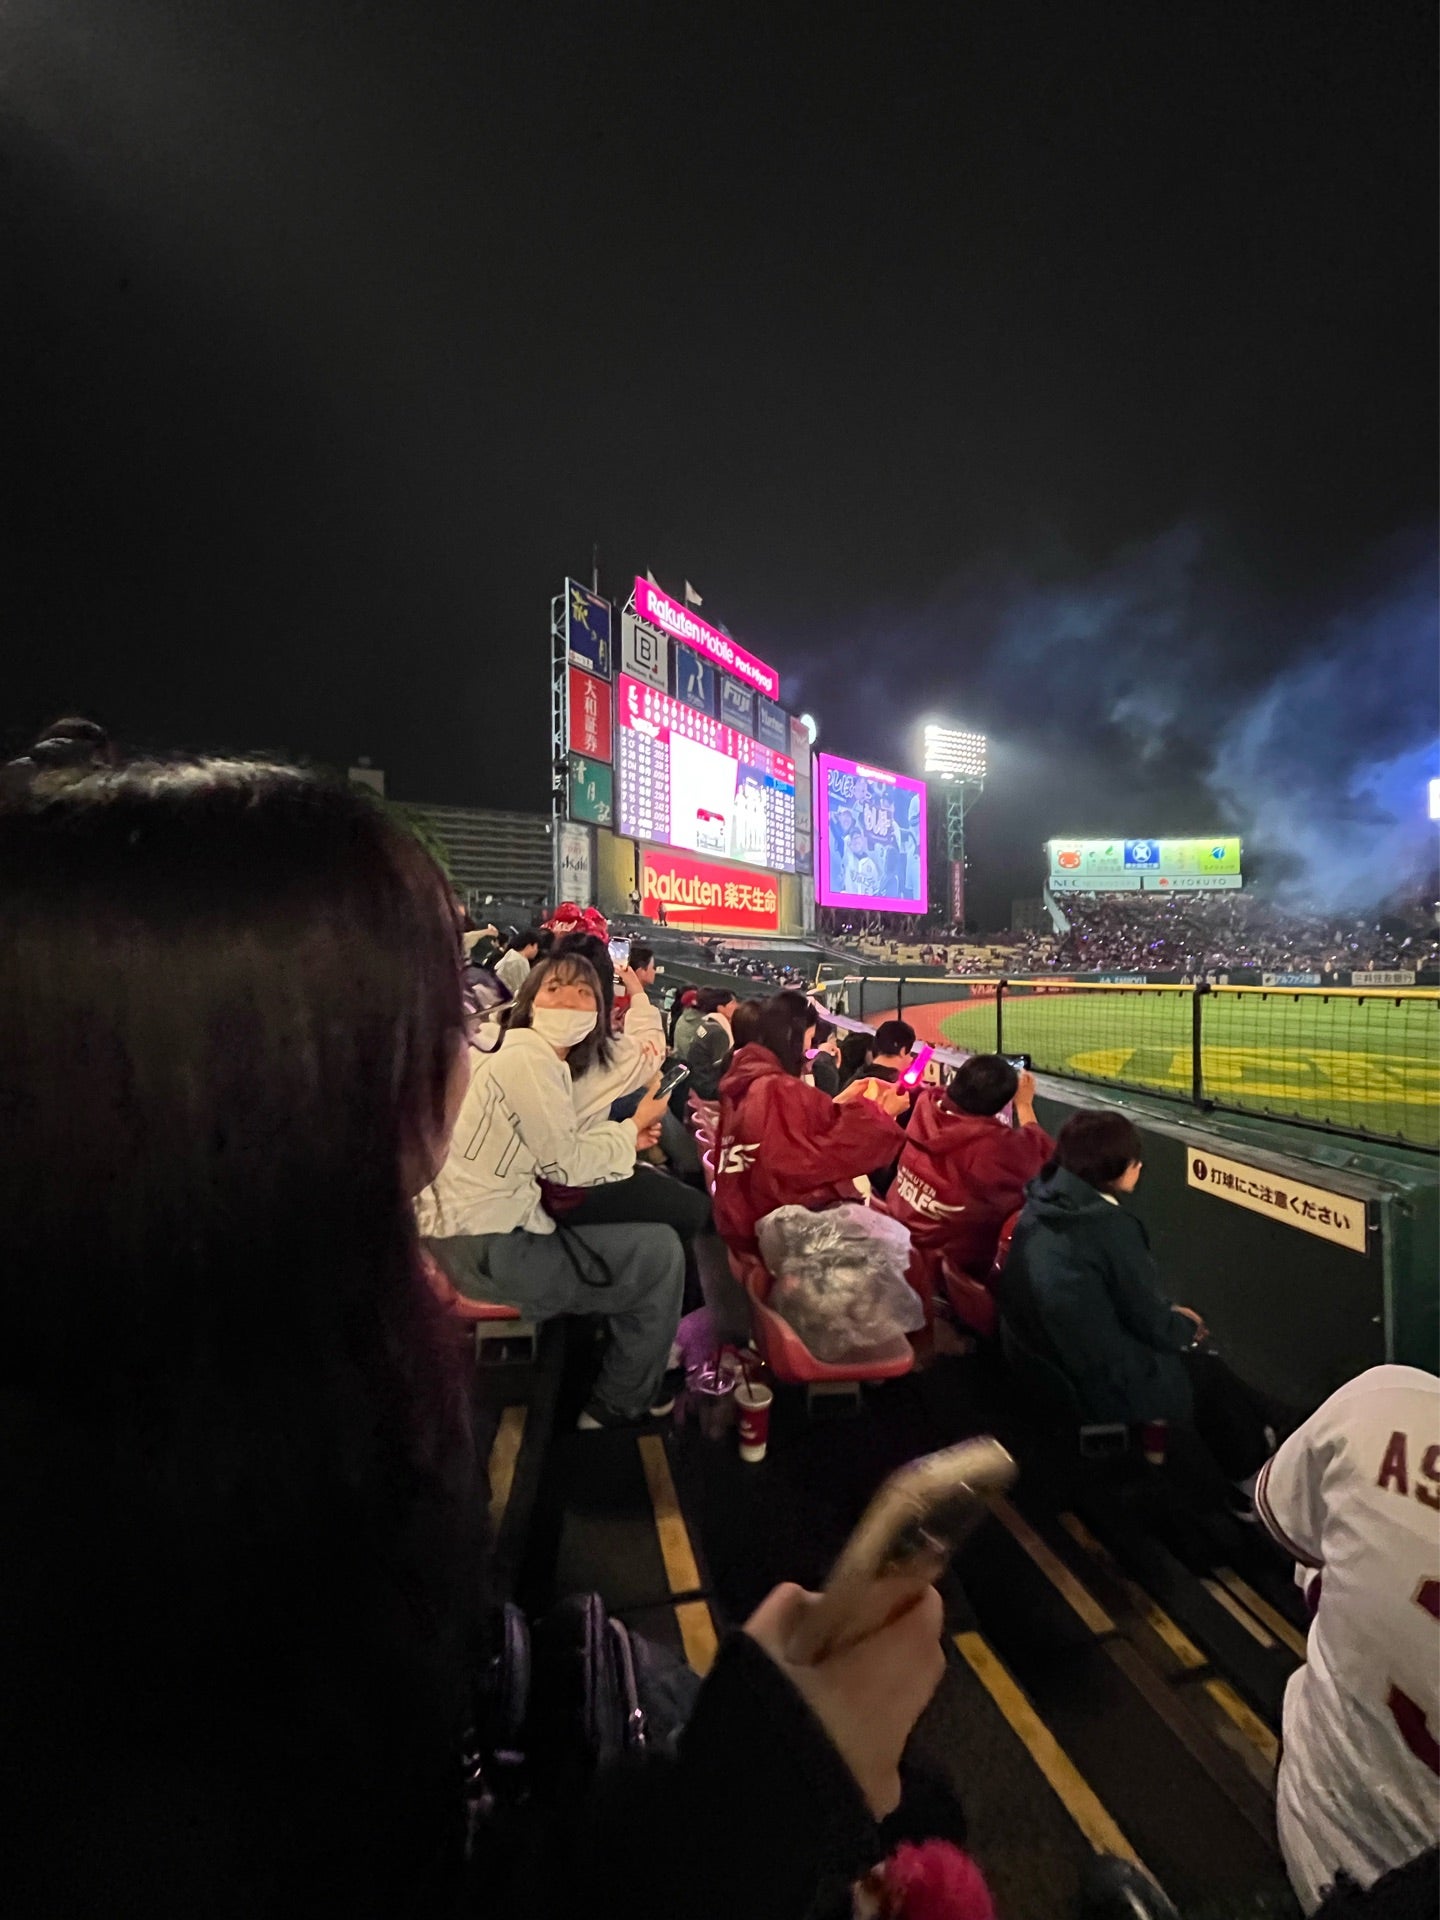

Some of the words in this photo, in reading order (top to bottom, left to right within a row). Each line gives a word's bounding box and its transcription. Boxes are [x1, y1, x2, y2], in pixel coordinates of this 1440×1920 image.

[647, 589, 700, 643] Rakuten
[701, 627, 734, 664] Mobile
[735, 656, 753, 676] Park
[752, 666, 773, 691] Miyagi
[583, 679, 598, 753] 大和証券
[644, 865, 722, 908] Rakuten
[724, 882, 777, 915] 楽天生命
[1053, 879, 1080, 887] NEC
[1172, 878, 1227, 886] KYOKUYO
[1211, 1168, 1350, 1229] 打球にご注意ください
